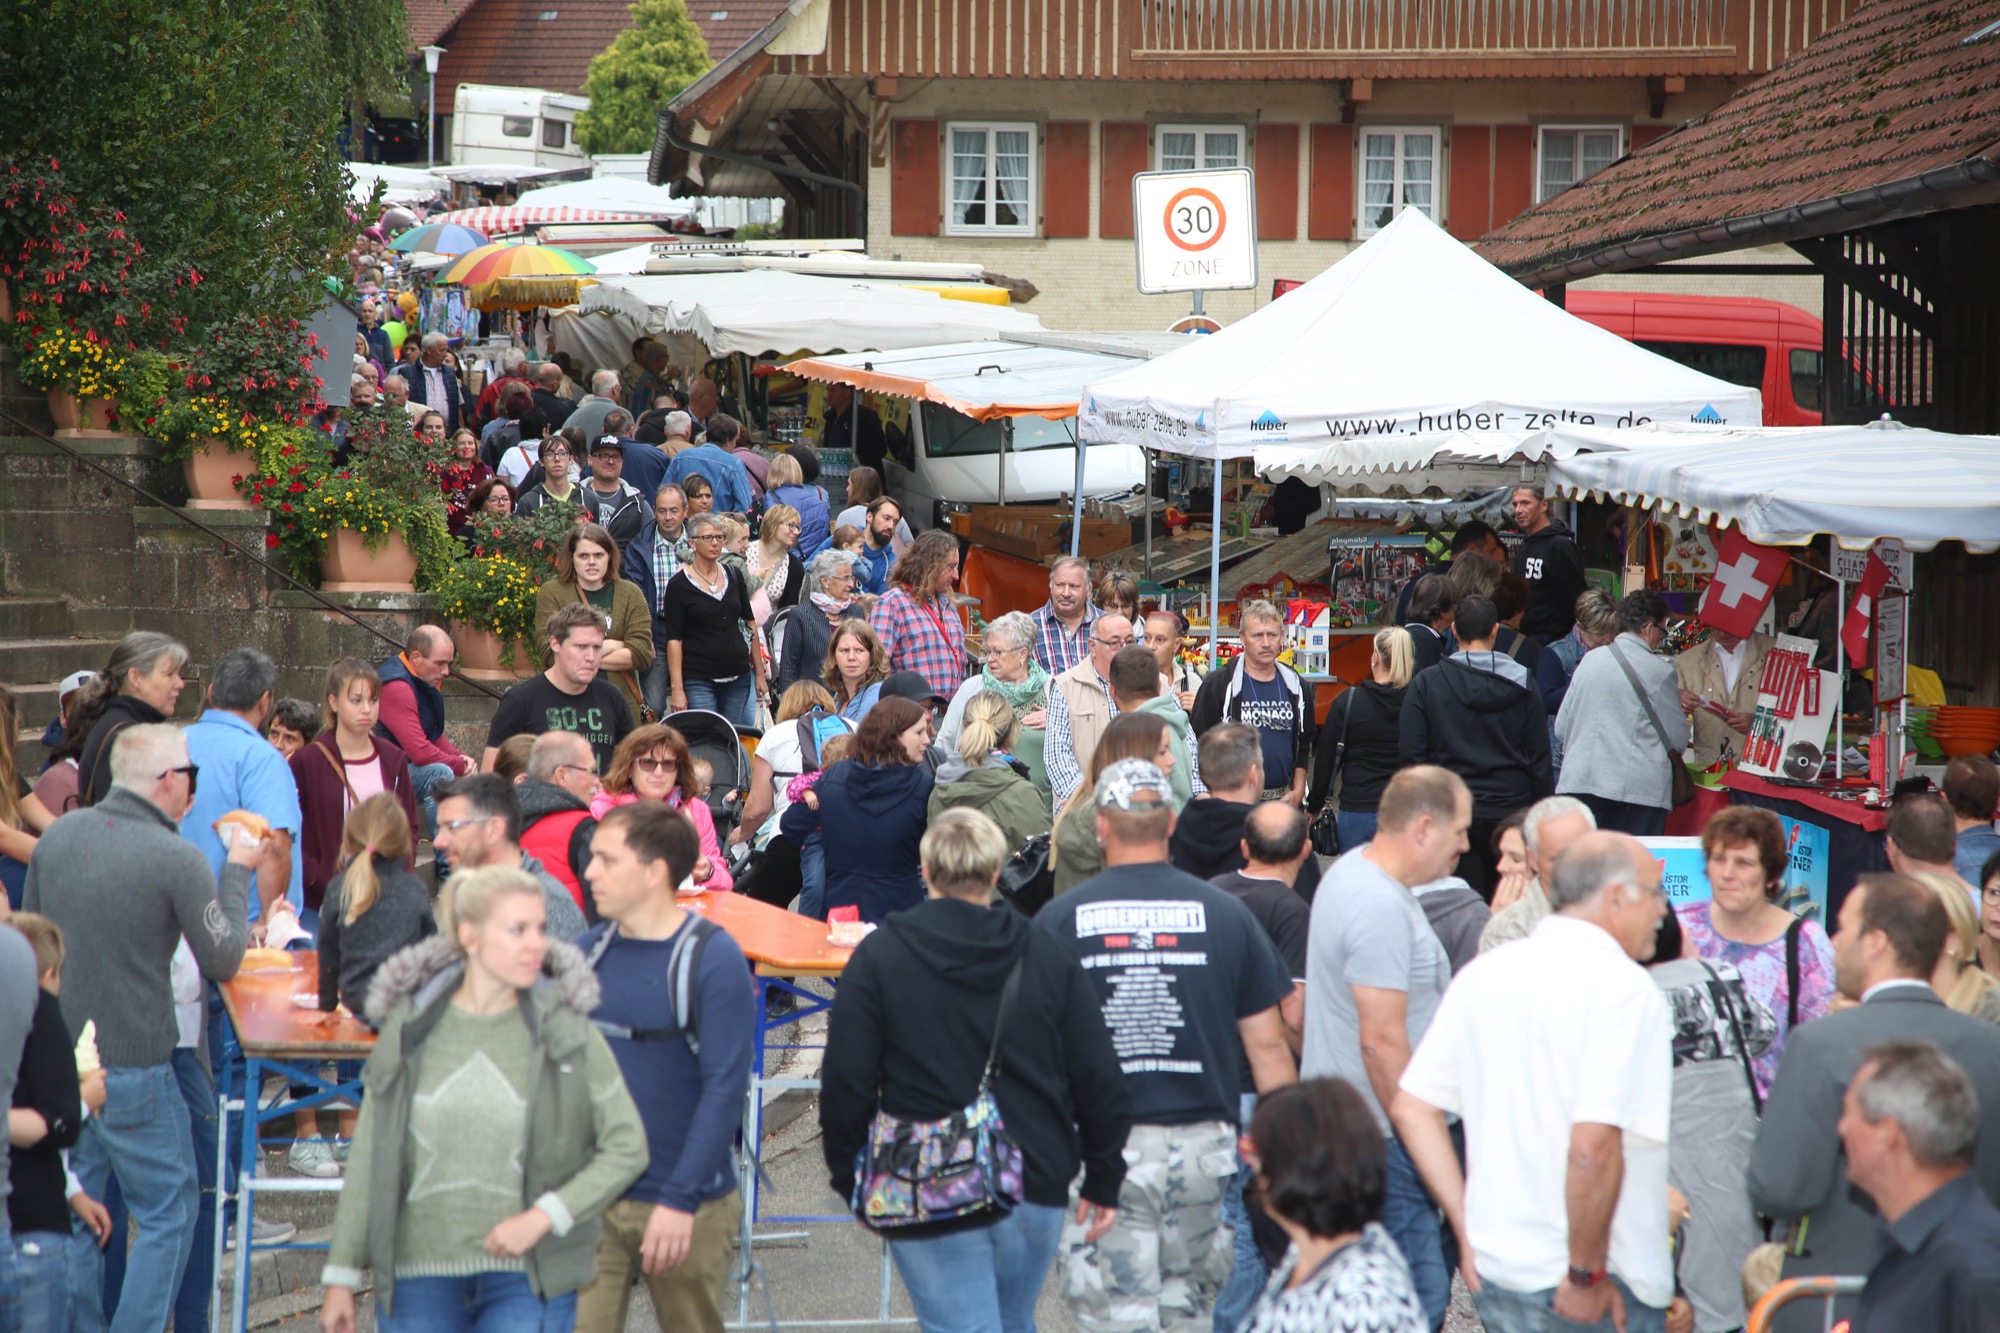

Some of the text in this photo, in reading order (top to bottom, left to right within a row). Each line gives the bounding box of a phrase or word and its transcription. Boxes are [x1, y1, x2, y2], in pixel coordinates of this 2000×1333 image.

[1177, 206, 1212, 234] 30
[1171, 259, 1224, 277] ZONE
[1250, 419, 1288, 431] huber
[1331, 536, 1368, 545] playmobil
[1525, 557, 1544, 580] 59
[545, 706, 603, 731] SO-C
[1241, 710, 1294, 720] MONACO
[1081, 906, 1200, 932] OHRENFEINDT
